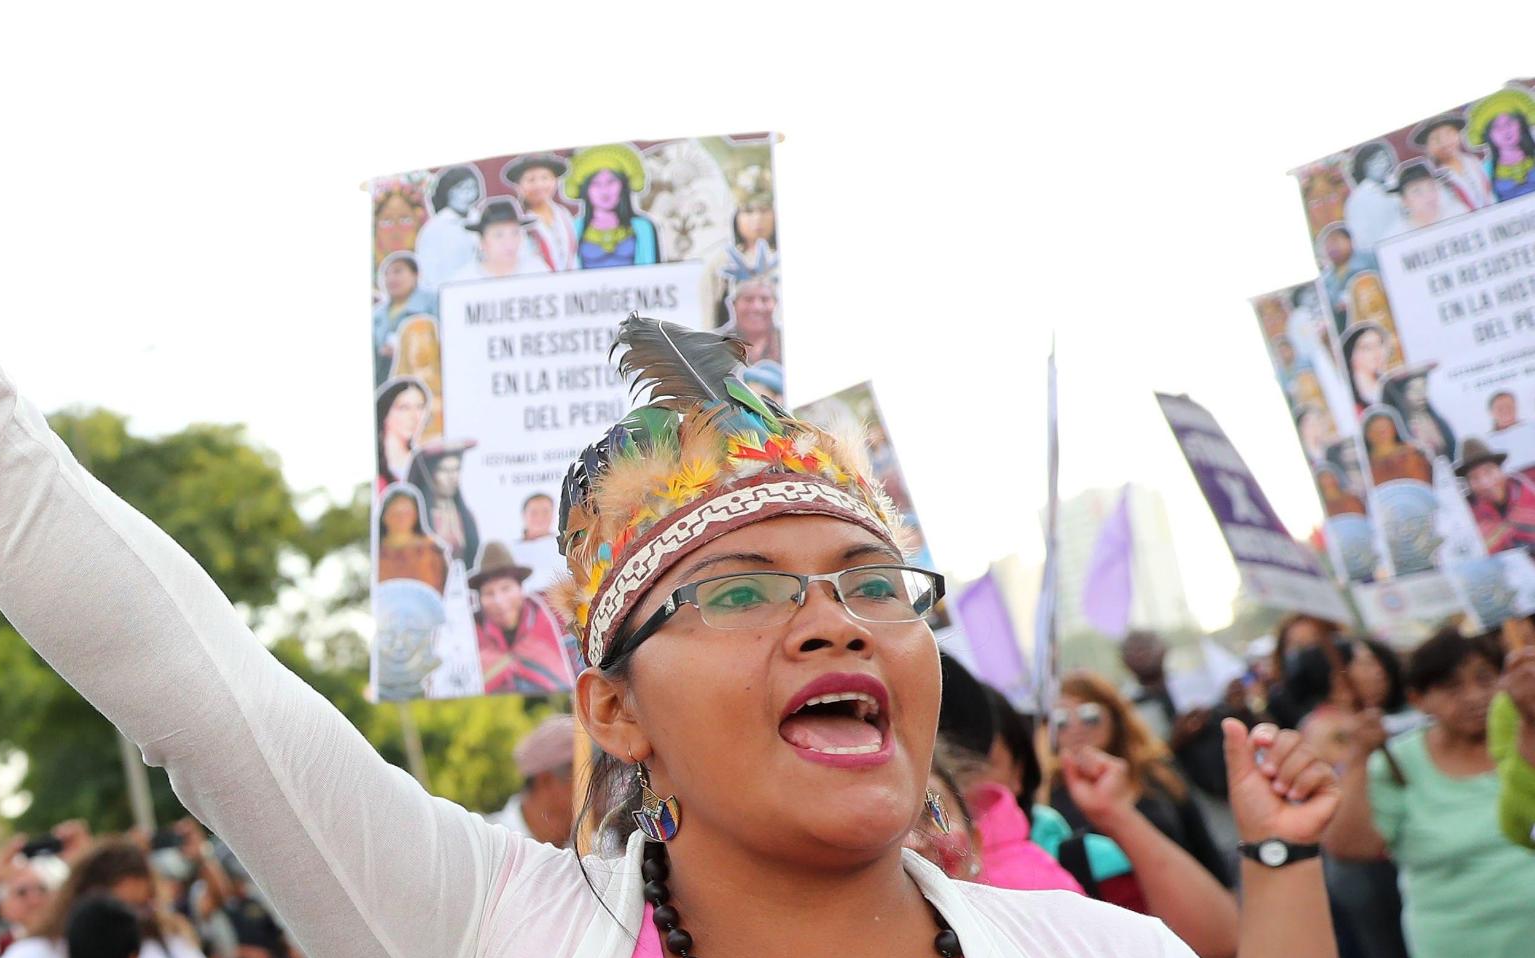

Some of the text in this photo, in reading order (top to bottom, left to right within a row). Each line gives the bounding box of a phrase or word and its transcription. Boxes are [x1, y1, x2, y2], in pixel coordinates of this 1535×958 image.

[1427, 242, 1535, 294] EN RESISTE
[465, 284, 678, 324] MUJERES INDÍGENAS
[1438, 273, 1535, 325] EN LA HIST
[487, 327, 616, 361] EN RESISTEN
[1472, 305, 1535, 345] DEL PE
[492, 364, 616, 396] EN LA HISTO
[524, 404, 561, 432] DEL
